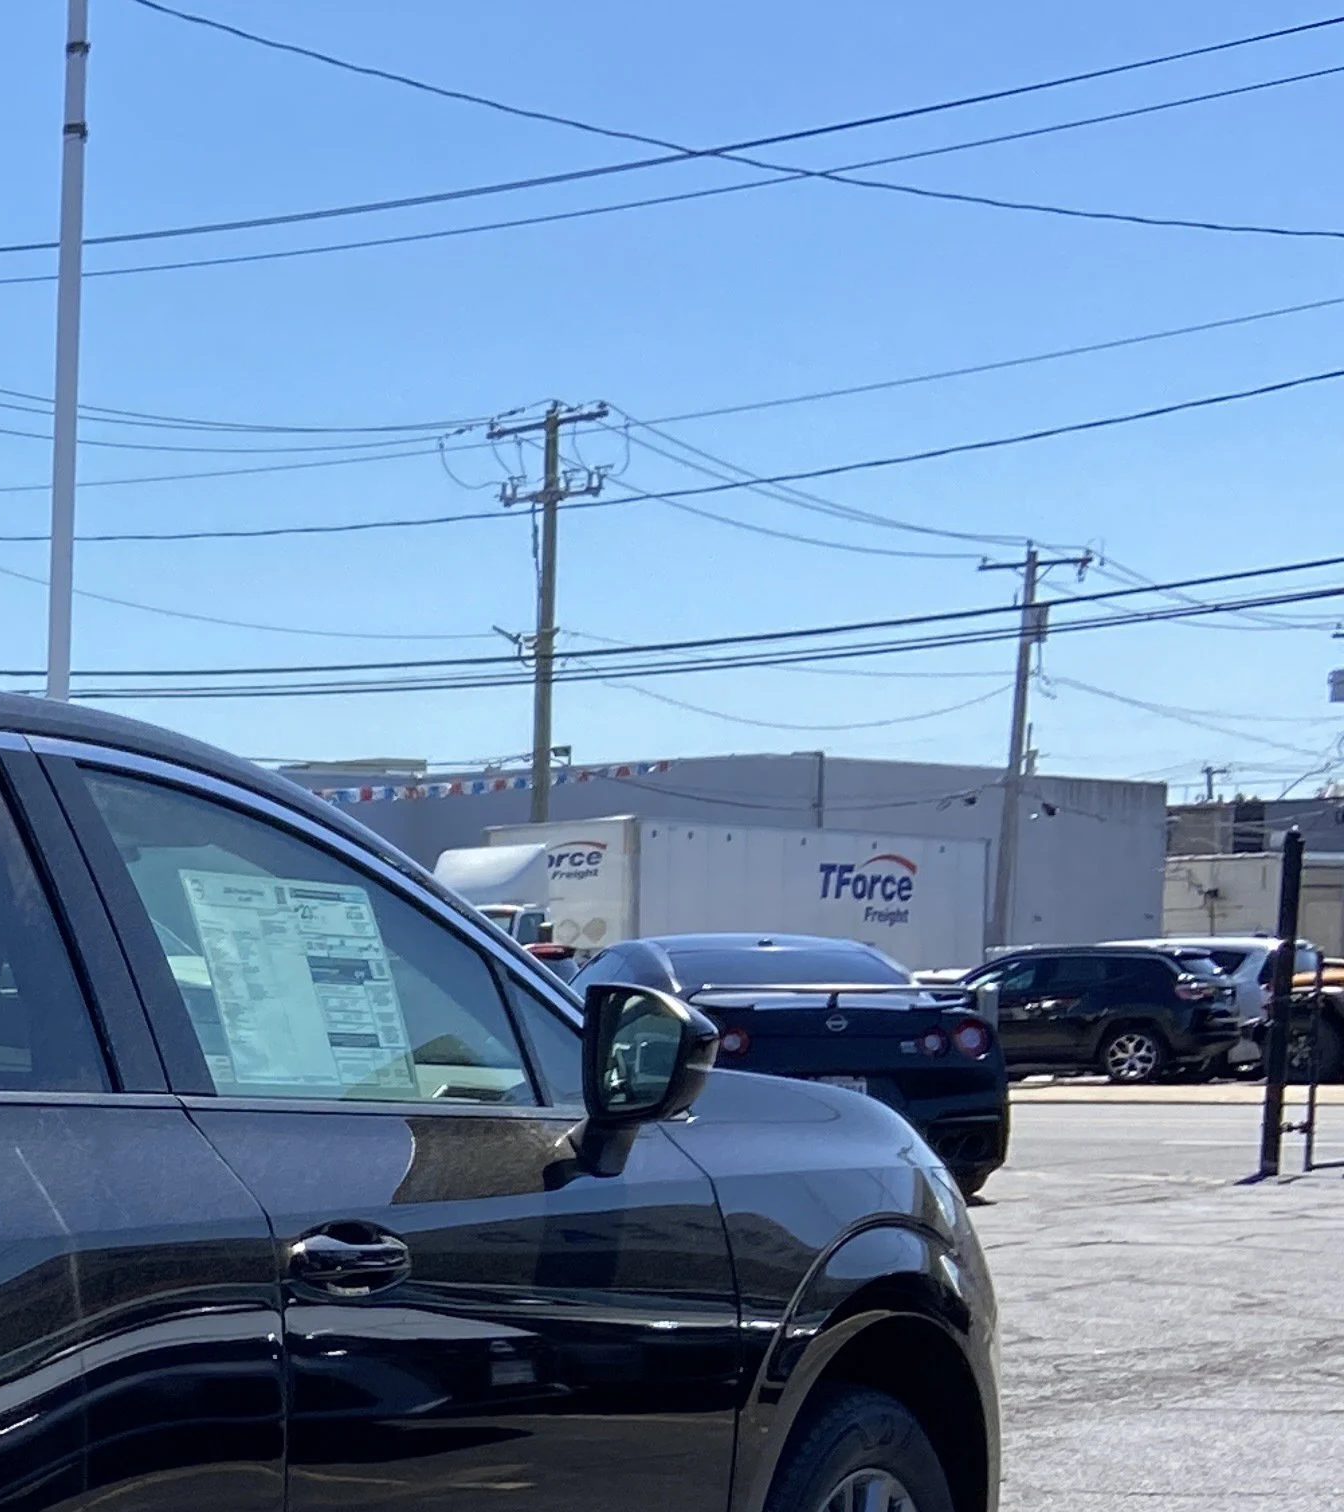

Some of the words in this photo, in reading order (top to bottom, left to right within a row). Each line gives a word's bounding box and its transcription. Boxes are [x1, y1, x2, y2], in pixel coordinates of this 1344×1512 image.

[547, 850, 603, 869] orce
[551, 868, 599, 880] Freight
[819, 863, 913, 902] TForce
[863, 905, 910, 928] Freight
